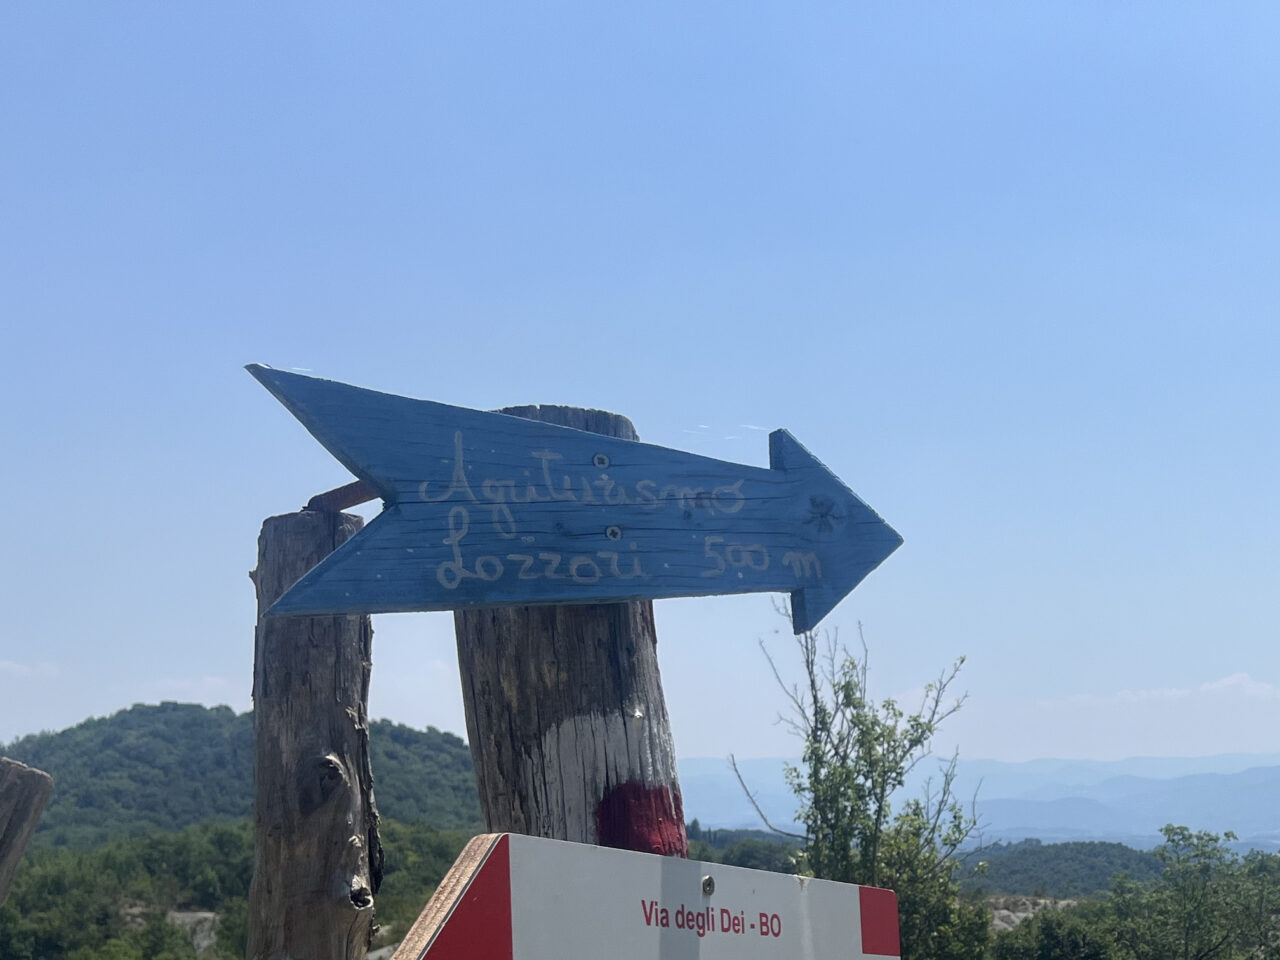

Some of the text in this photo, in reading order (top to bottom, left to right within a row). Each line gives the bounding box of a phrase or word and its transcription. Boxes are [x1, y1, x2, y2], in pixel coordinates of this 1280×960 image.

[701, 535, 771, 578] 500
[641, 899, 670, 928] Via
[674, 904, 716, 938] degli
[720, 908, 746, 934] Dei
[759, 912, 782, 938] BO
